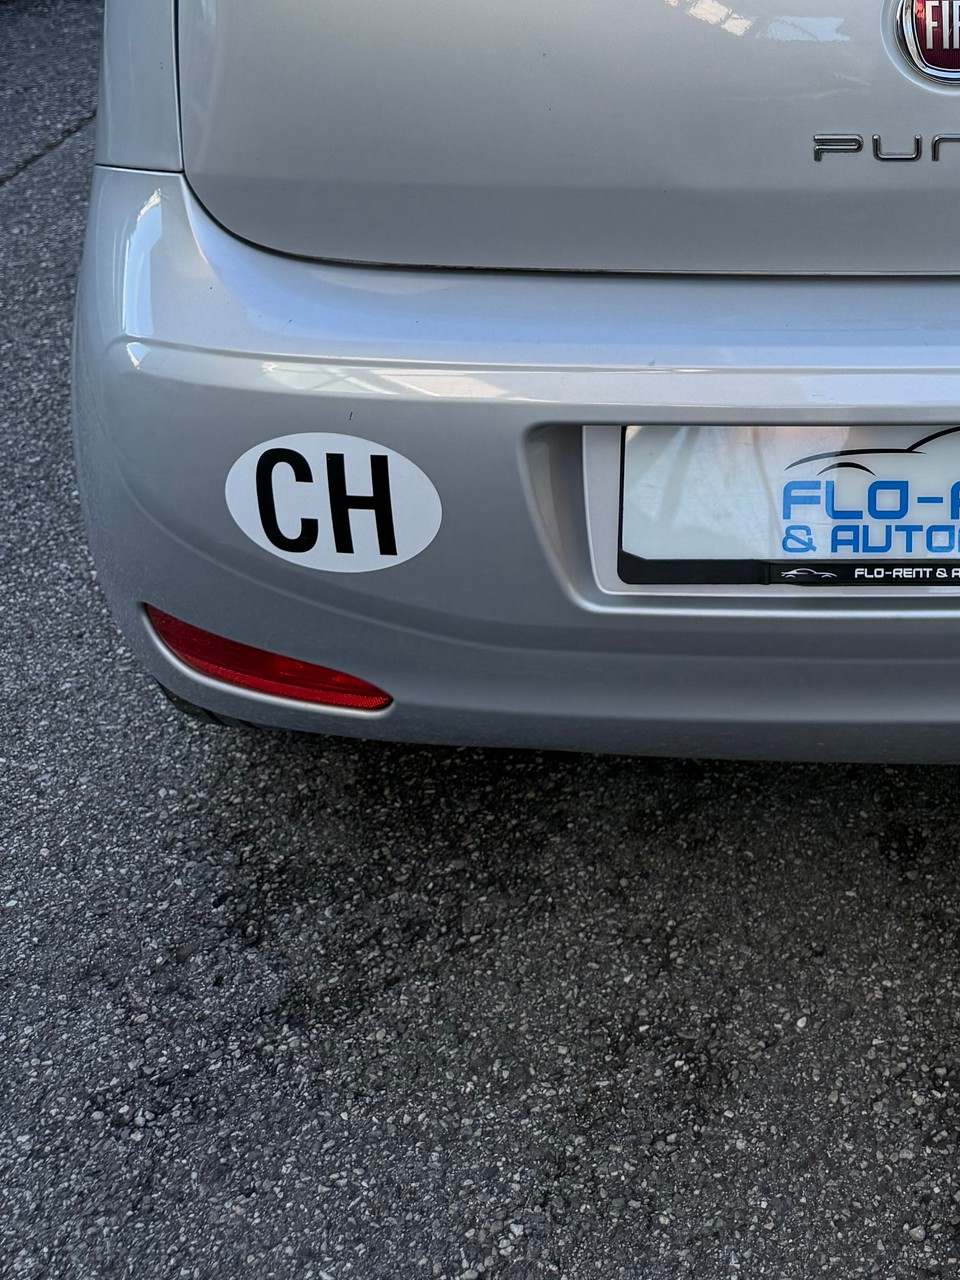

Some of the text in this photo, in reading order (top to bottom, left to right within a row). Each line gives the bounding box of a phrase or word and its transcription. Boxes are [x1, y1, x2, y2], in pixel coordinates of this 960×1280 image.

[255, 447, 398, 556] CH
[781, 524, 818, 554] &
[854, 567, 933, 578] FLO-RENT
[936, 568, 948, 578] &
